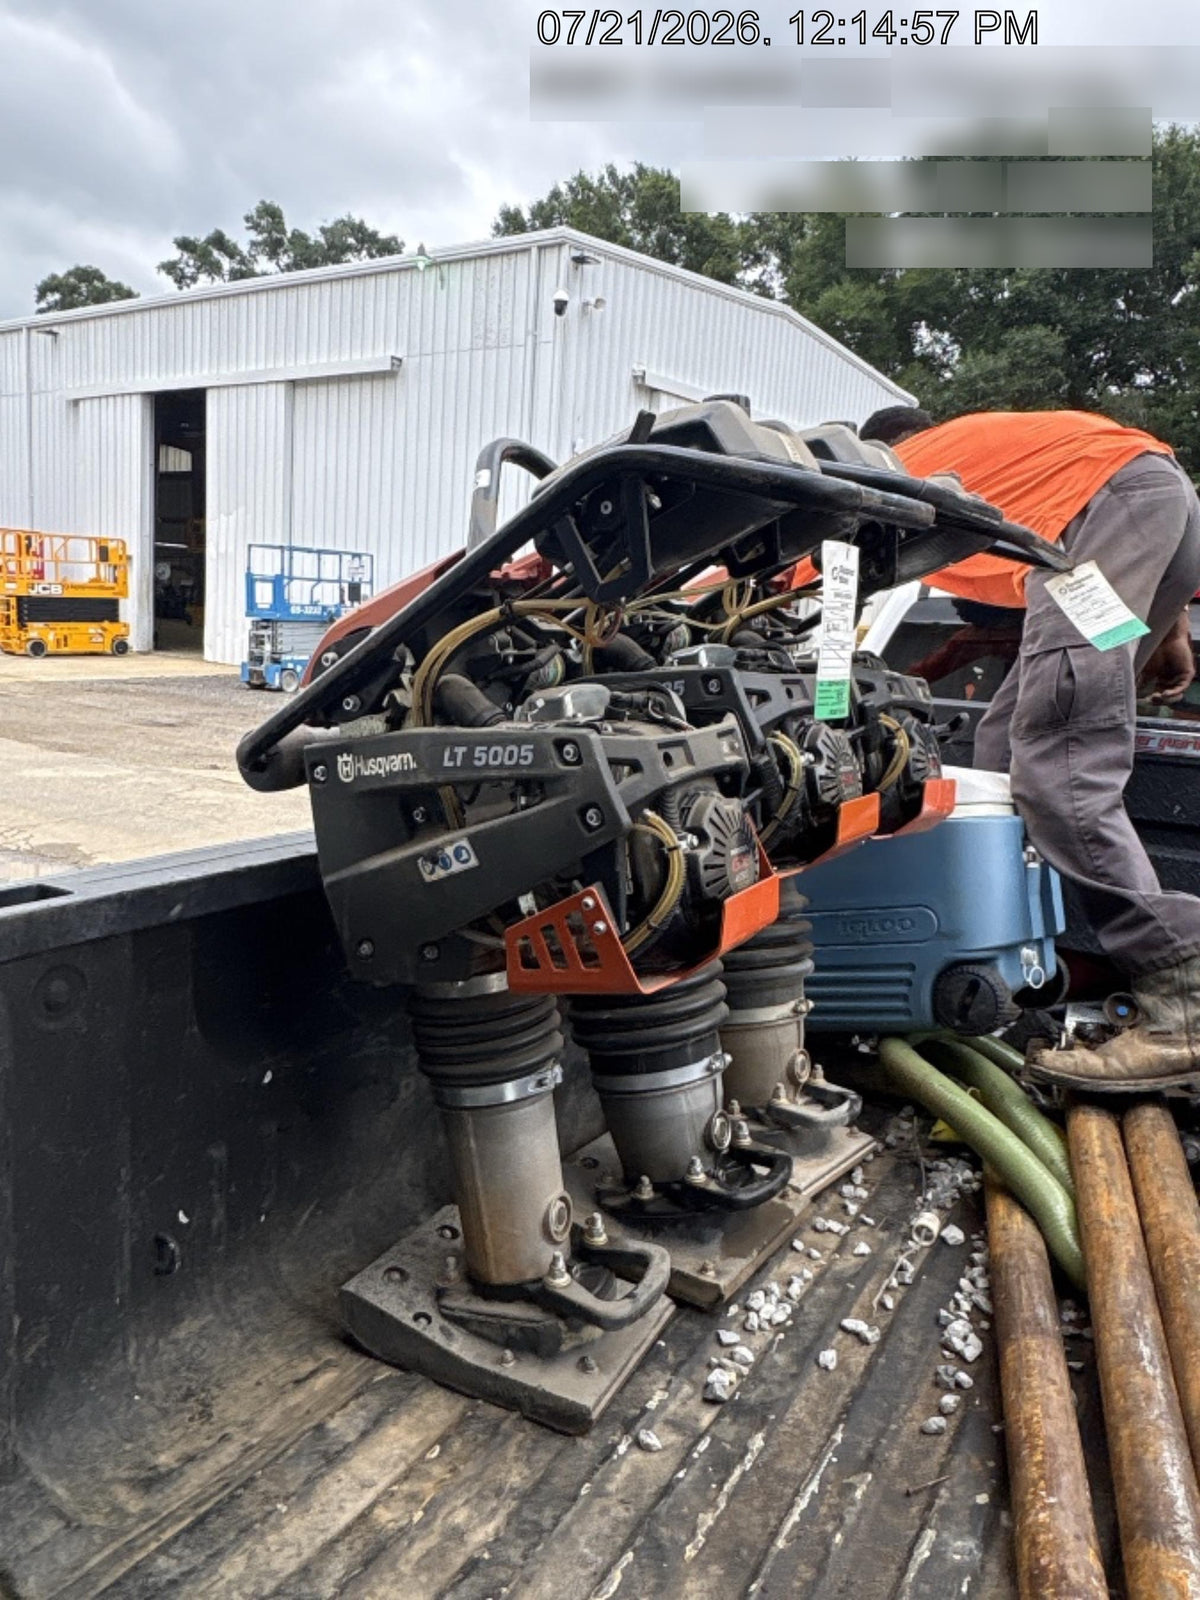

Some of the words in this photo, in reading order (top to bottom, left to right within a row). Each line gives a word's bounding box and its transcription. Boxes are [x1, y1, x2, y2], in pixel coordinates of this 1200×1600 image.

[28, 583, 63, 595] JCB
[443, 746, 468, 767] LT
[473, 744, 534, 767] 5005
